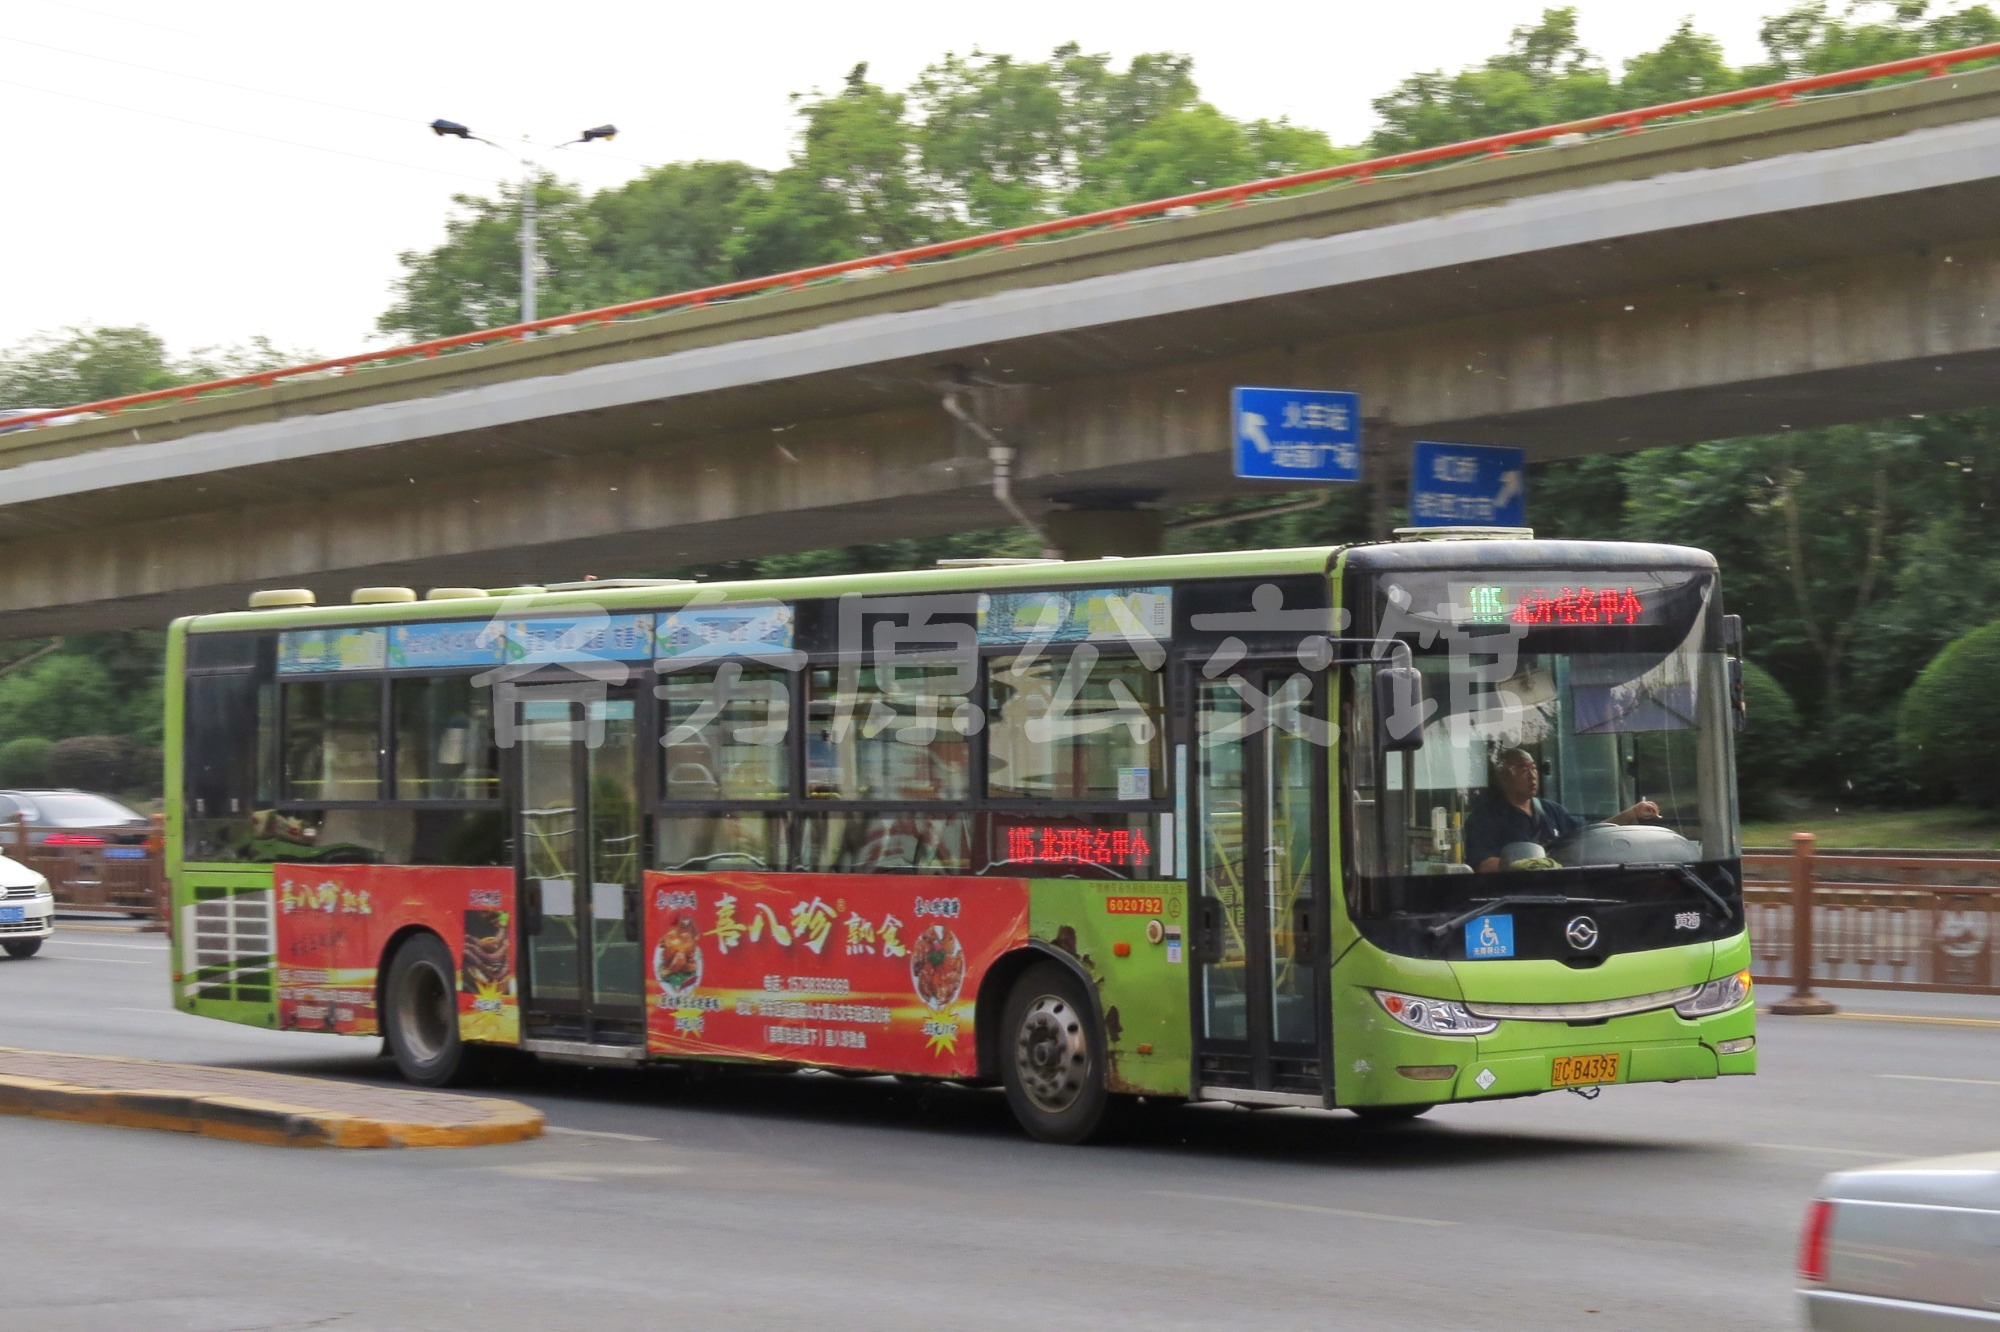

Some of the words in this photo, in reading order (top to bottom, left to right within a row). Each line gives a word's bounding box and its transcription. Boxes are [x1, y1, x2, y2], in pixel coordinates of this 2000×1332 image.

[1470, 586, 1504, 623] 105
[1109, 898, 1161, 914] 6020792
[1674, 911, 1701, 930] 黄海
[1478, 1074, 1494, 1084] LNG
